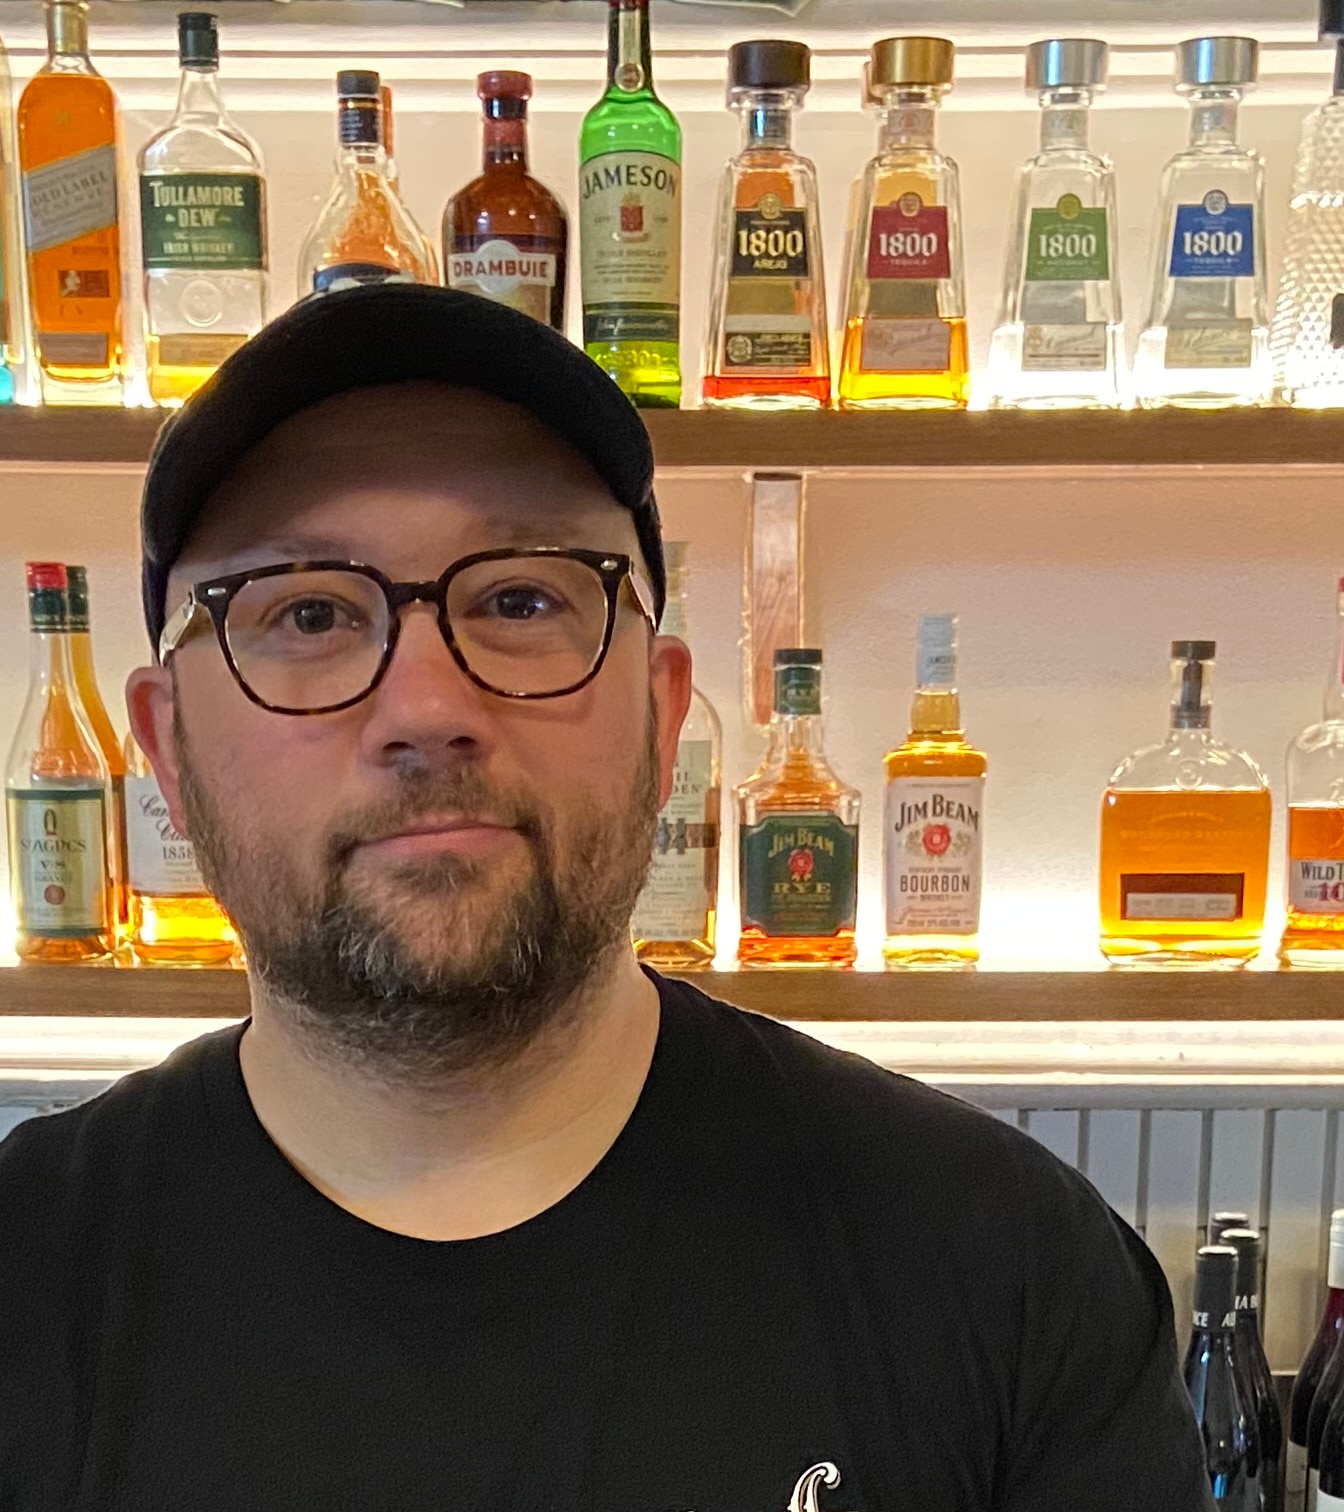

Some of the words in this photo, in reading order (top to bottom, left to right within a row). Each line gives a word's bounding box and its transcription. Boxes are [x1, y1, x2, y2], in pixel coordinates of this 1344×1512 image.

[149, 180, 245, 207] TULLAMORE
[582, 163, 676, 200] JAMESON
[178, 208, 218, 228] DEW
[737, 229, 804, 257] 1800
[879, 231, 938, 257] 1800
[1039, 233, 1097, 258] 1800
[1183, 230, 1244, 256] 1800
[455, 260, 548, 279] DRAMBUIE
[895, 801, 929, 832] JIM
[932, 793, 979, 832] BEAM
[768, 833, 796, 858] JIM
[797, 827, 835, 857] BEAM
[900, 875, 970, 892] BOURBON
[1300, 862, 1335, 881] WILD
[773, 882, 832, 894] RYE
